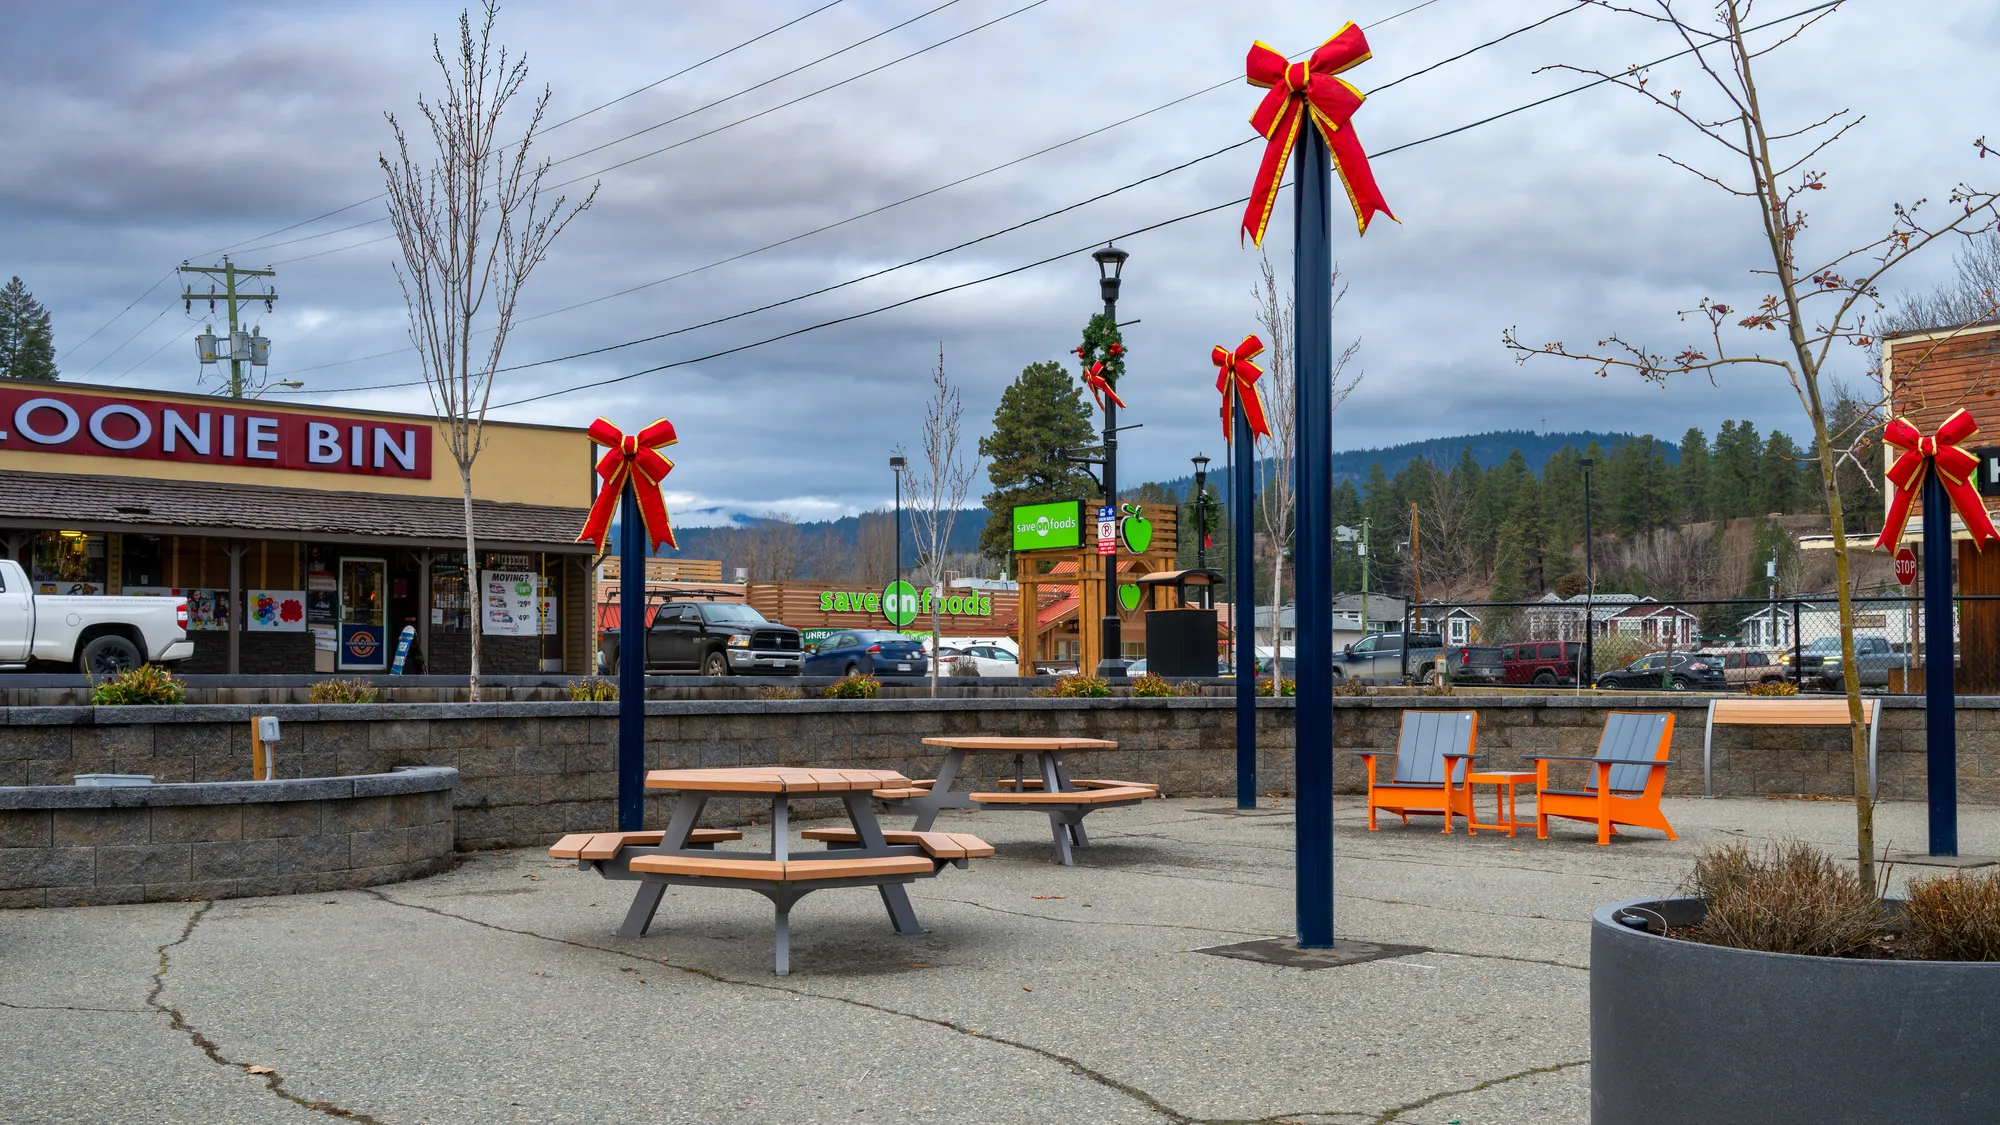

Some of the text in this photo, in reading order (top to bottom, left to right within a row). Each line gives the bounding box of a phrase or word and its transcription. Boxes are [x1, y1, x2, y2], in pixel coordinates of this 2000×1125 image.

[0, 397, 416, 471] OONIE BIN
[1016, 522, 1036, 533] save
[1050, 516, 1076, 530] foods
[1895, 560, 1915, 574] STOP
[491, 572, 530, 583] MOVING?
[819, 591, 879, 613] save
[885, 593, 916, 613] on
[805, 631, 834, 640] UNREA
